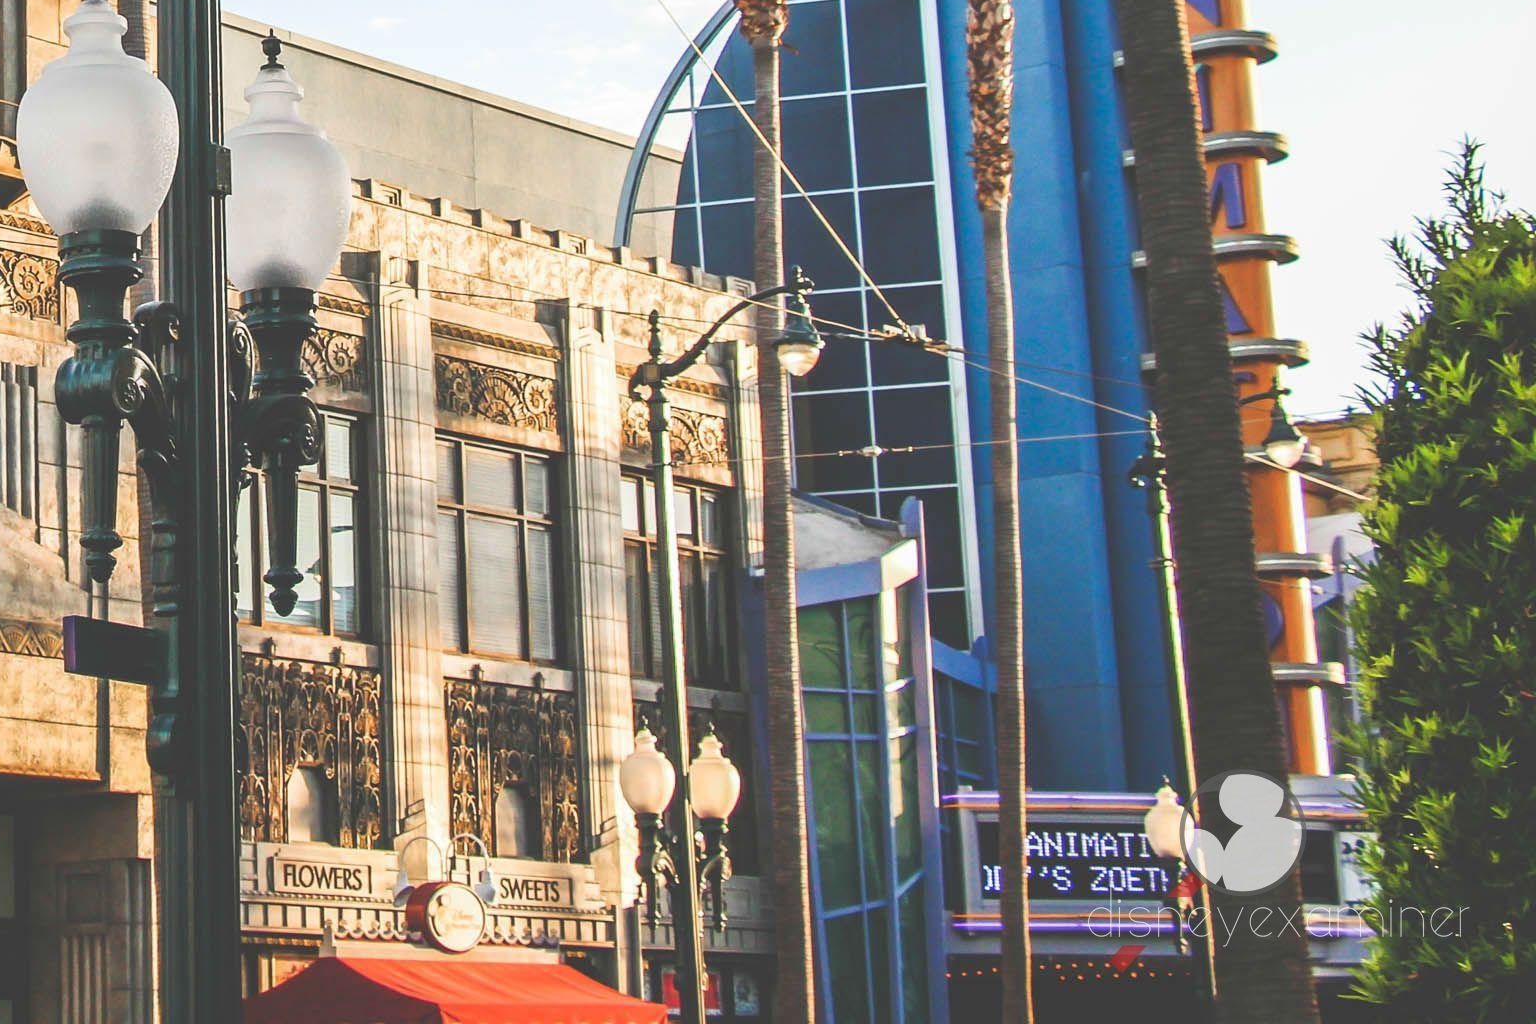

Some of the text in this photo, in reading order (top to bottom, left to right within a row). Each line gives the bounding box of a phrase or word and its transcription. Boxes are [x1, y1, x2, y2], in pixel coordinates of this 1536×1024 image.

[1024, 832, 1152, 857] ANIMATI
[283, 863, 362, 891] FLOWERS
[500, 878, 560, 902] SWEETS
